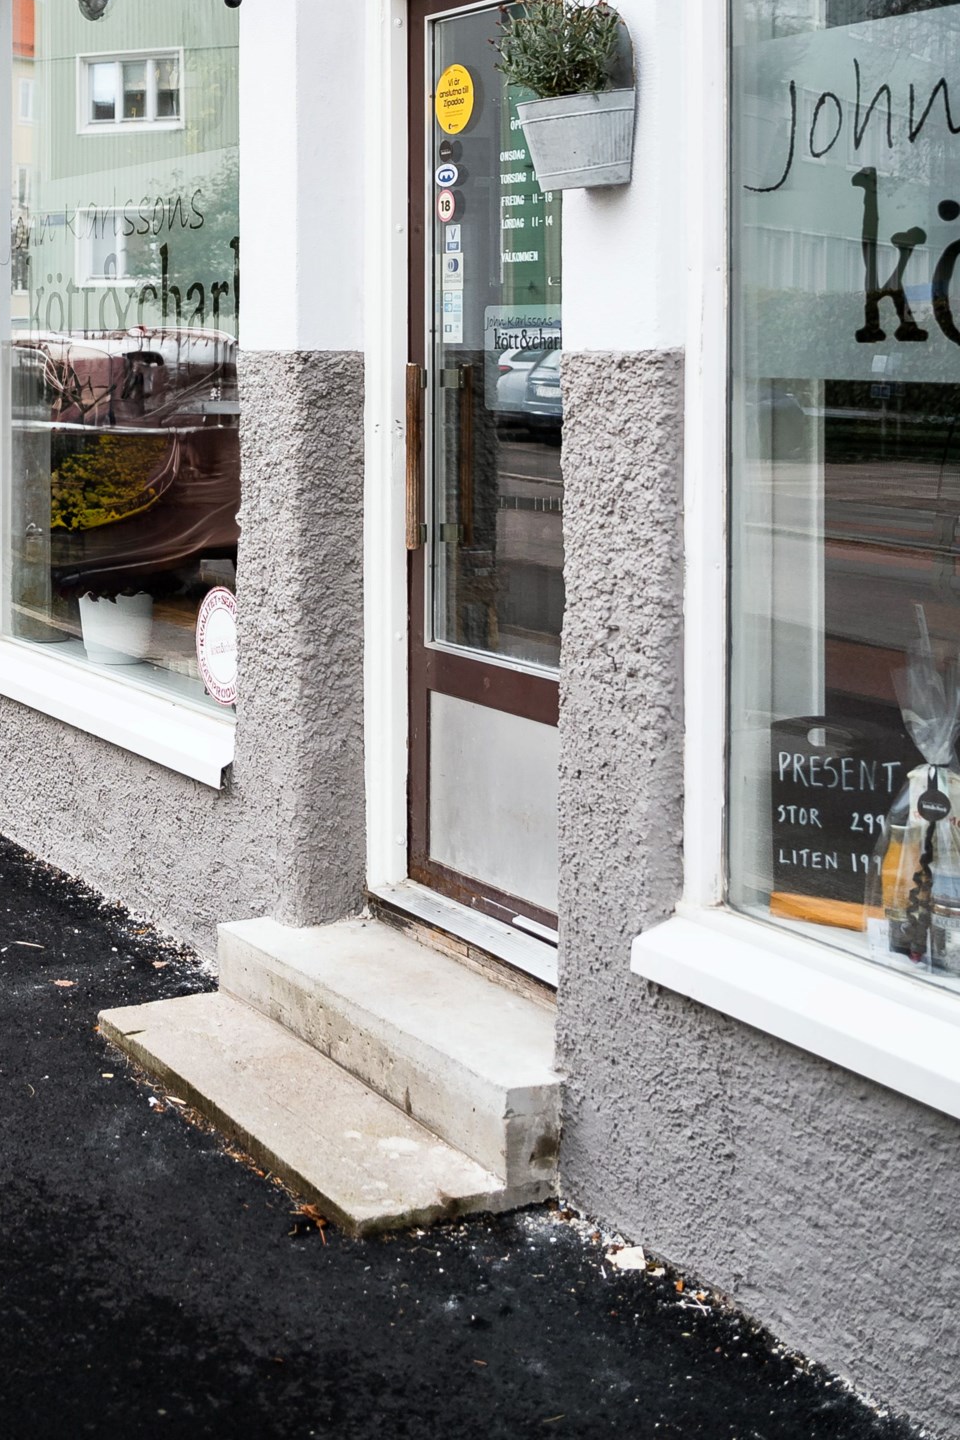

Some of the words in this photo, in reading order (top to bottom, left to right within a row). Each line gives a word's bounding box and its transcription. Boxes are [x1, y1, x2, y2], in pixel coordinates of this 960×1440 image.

[500, 149, 525, 162] ONSDAG
[500, 172, 527, 184] TORSDAG
[440, 200, 451, 212] 18
[501, 195, 525, 207] FREDAG
[501, 214, 525, 229] LÖRDAG
[501, 249, 539, 262] VÄLKOMMEN
[778, 751, 901, 793] PRESENT
[777, 805, 822, 828] STOR
[850, 812, 886, 836] 299
[779, 848, 838, 869] LITEN
[851, 852, 882, 876] 199
